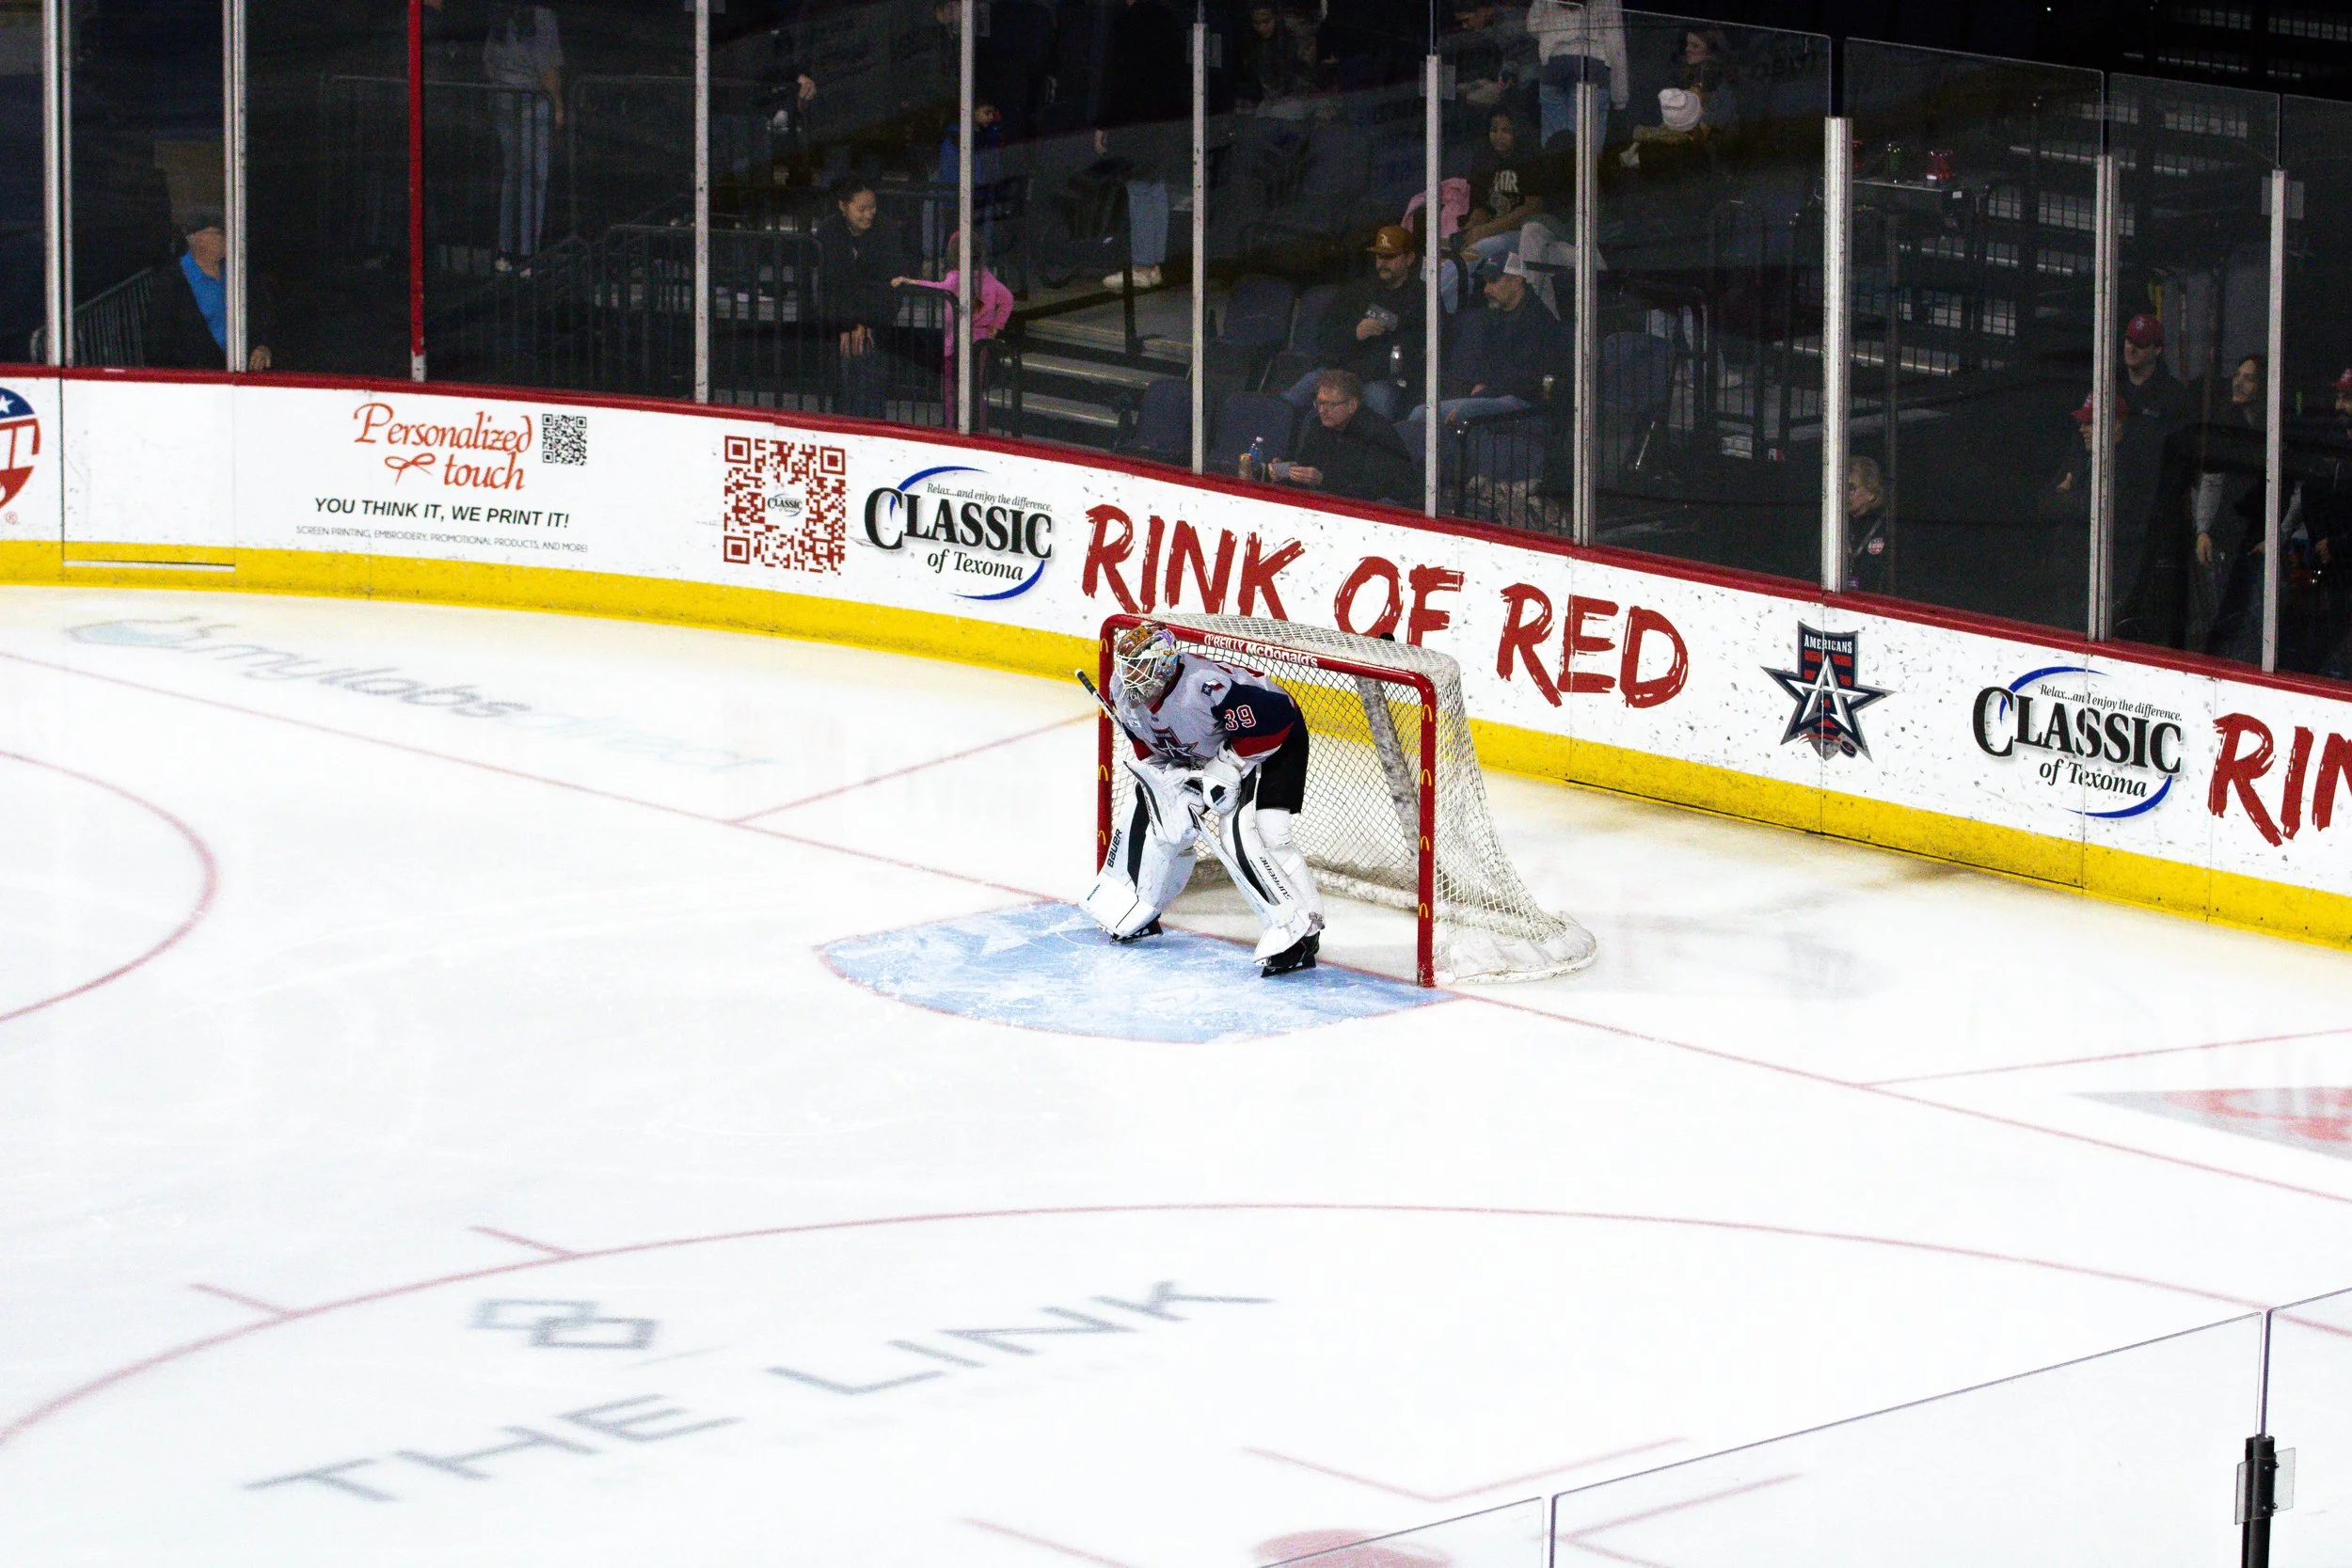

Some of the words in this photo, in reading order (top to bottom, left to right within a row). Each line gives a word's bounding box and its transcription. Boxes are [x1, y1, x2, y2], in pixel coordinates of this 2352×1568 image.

[354, 403, 532, 452] Personalized
[444, 451, 525, 490] touch
[315, 497, 356, 514] YOU
[362, 499, 419, 517] THINK
[424, 503, 445, 522] IT,
[452, 505, 482, 522] WE
[486, 508, 543, 526] PRINT
[548, 513, 569, 528] IT!
[975, 491, 995, 504] enjoy
[998, 493, 1011, 504] the
[1011, 496, 1052, 512] difference.
[296, 525, 329, 535] SCREEN
[430, 533, 491, 546] PROMOTIONAL
[542, 541, 560, 551] AND
[865, 487, 1052, 559] CLASSIC
[927, 548, 949, 574] of
[954, 551, 1024, 580] Texoma
[1082, 504, 1305, 621] RINK
[1334, 556, 1465, 647] OF
[1496, 582, 1689, 708] RED
[1246, 641, 1318, 667] McDonald's
[1804, 634, 1852, 654] AMERICANS
[1224, 705, 1256, 731] 39
[2092, 696, 2118, 711] enjoy
[2119, 700, 2134, 712] the
[2135, 703, 2183, 721] difference.
[1973, 687, 2181, 773] CLASSIC
[2040, 758, 2064, 786] of
[2066, 762, 2147, 798] Texoma
[1106, 829, 1122, 868] BAUER
[1259, 856, 1294, 900] SUPREME
[243, 1392, 743, 1502] THE
[764, 1279, 1277, 1396] LINK
